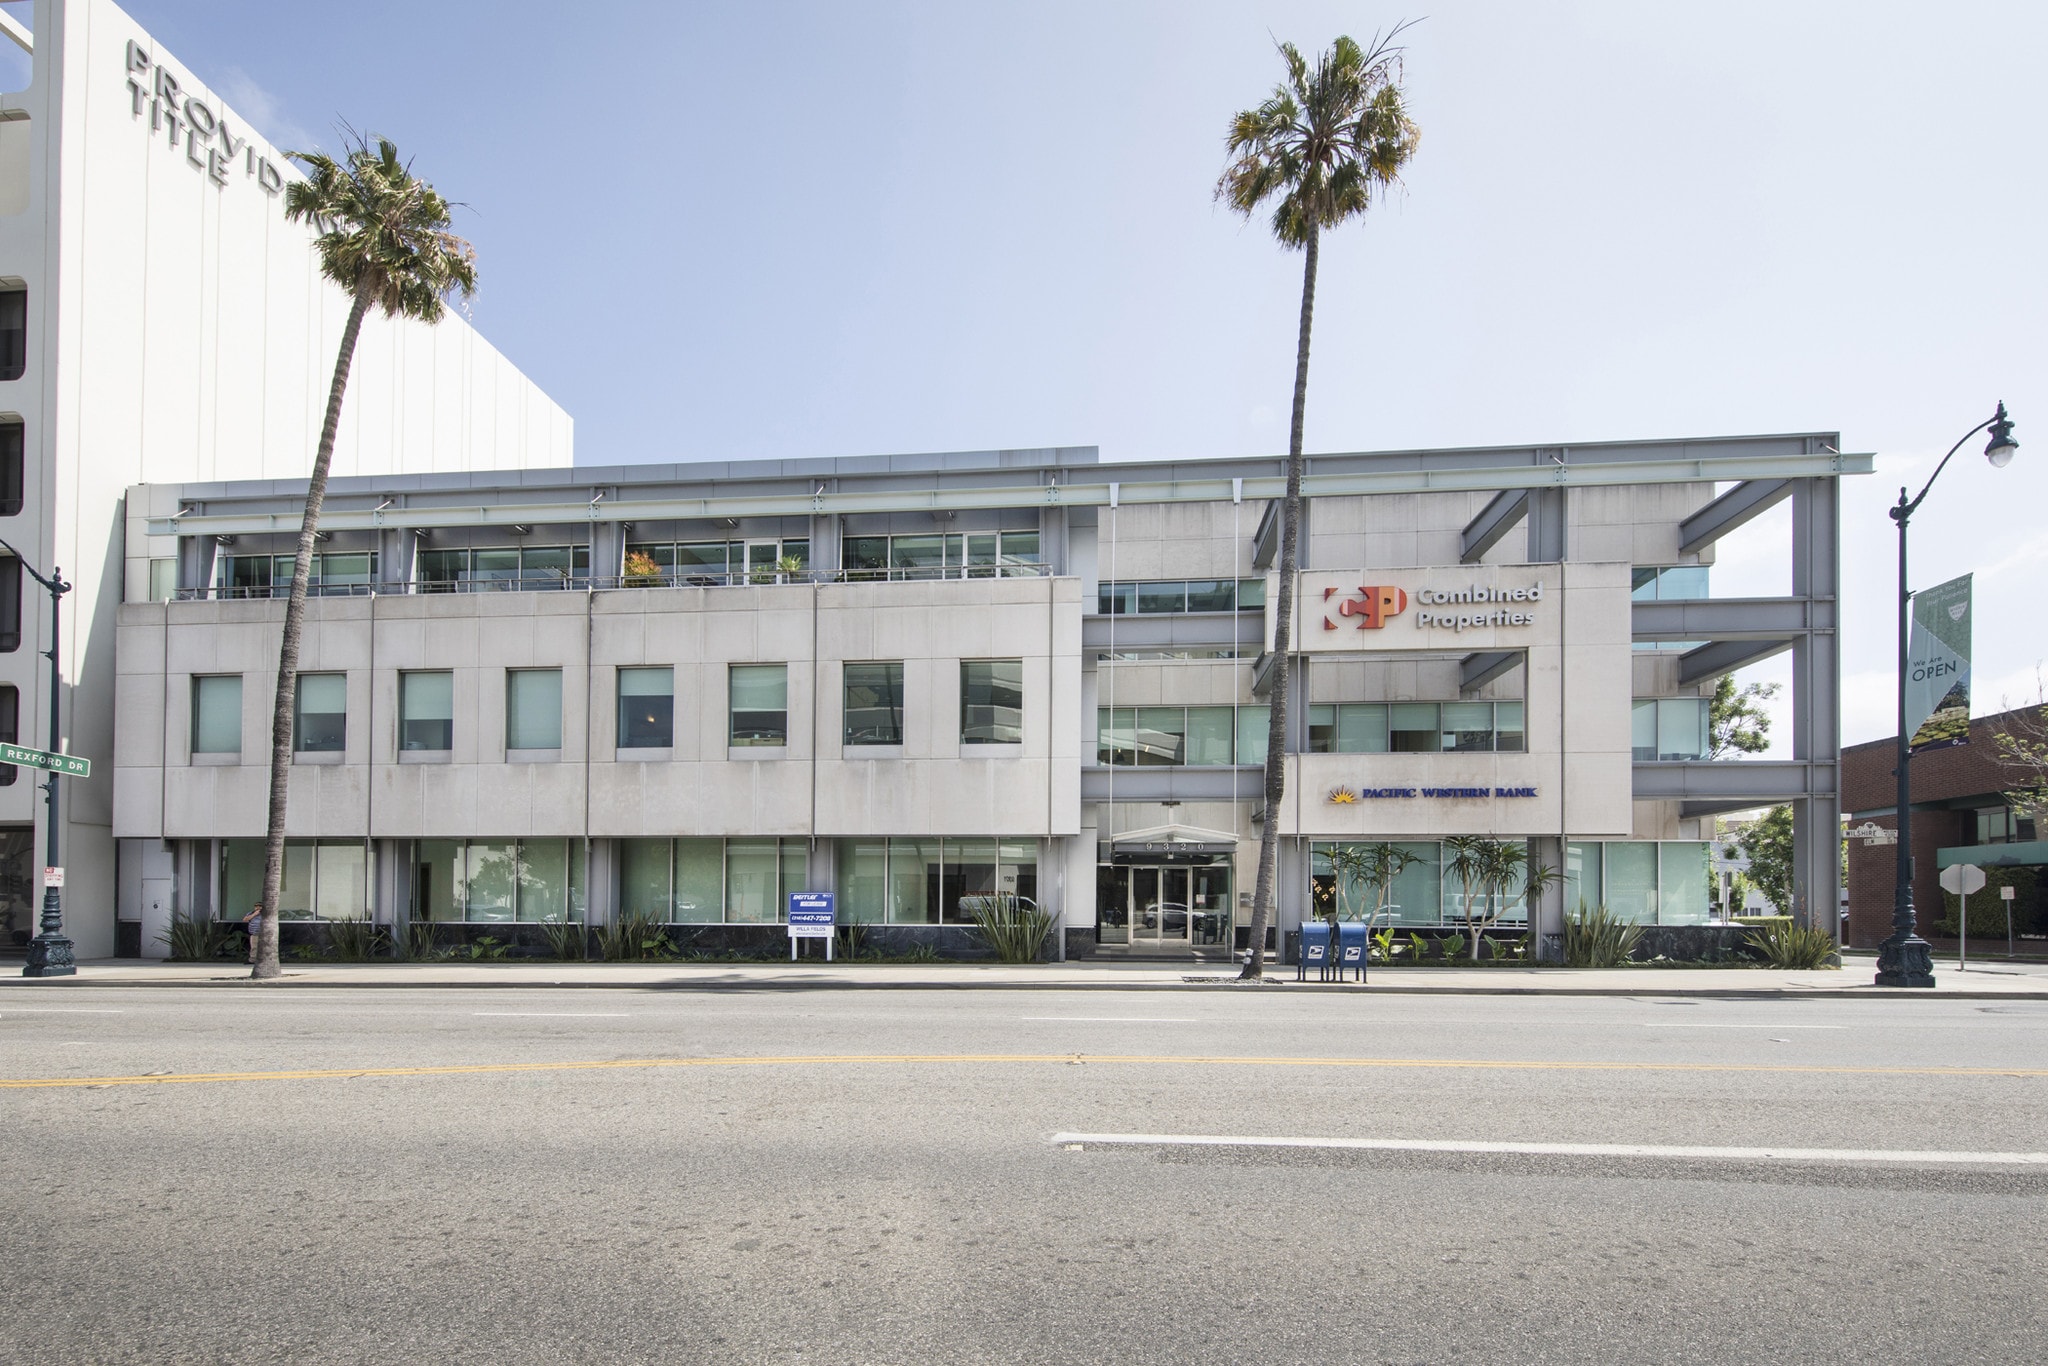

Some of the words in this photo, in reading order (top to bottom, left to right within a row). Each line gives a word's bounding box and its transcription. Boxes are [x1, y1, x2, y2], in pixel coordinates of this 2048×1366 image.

[126, 77, 229, 188] TITLE
[1417, 581, 1543, 604] Combined
[1416, 608, 1535, 632] Properties
[1912, 660, 1956, 681] OPEN
[1929, 656, 1942, 664] Are
[7, 749, 62, 767] REXFORD
[68, 761, 83, 771] DR
[1362, 788, 1416, 798] PACIFIC
[1421, 787, 1490, 798] WESTERN
[1495, 787, 1538, 797] BANK
[1146, 843, 1204, 851] 9320
